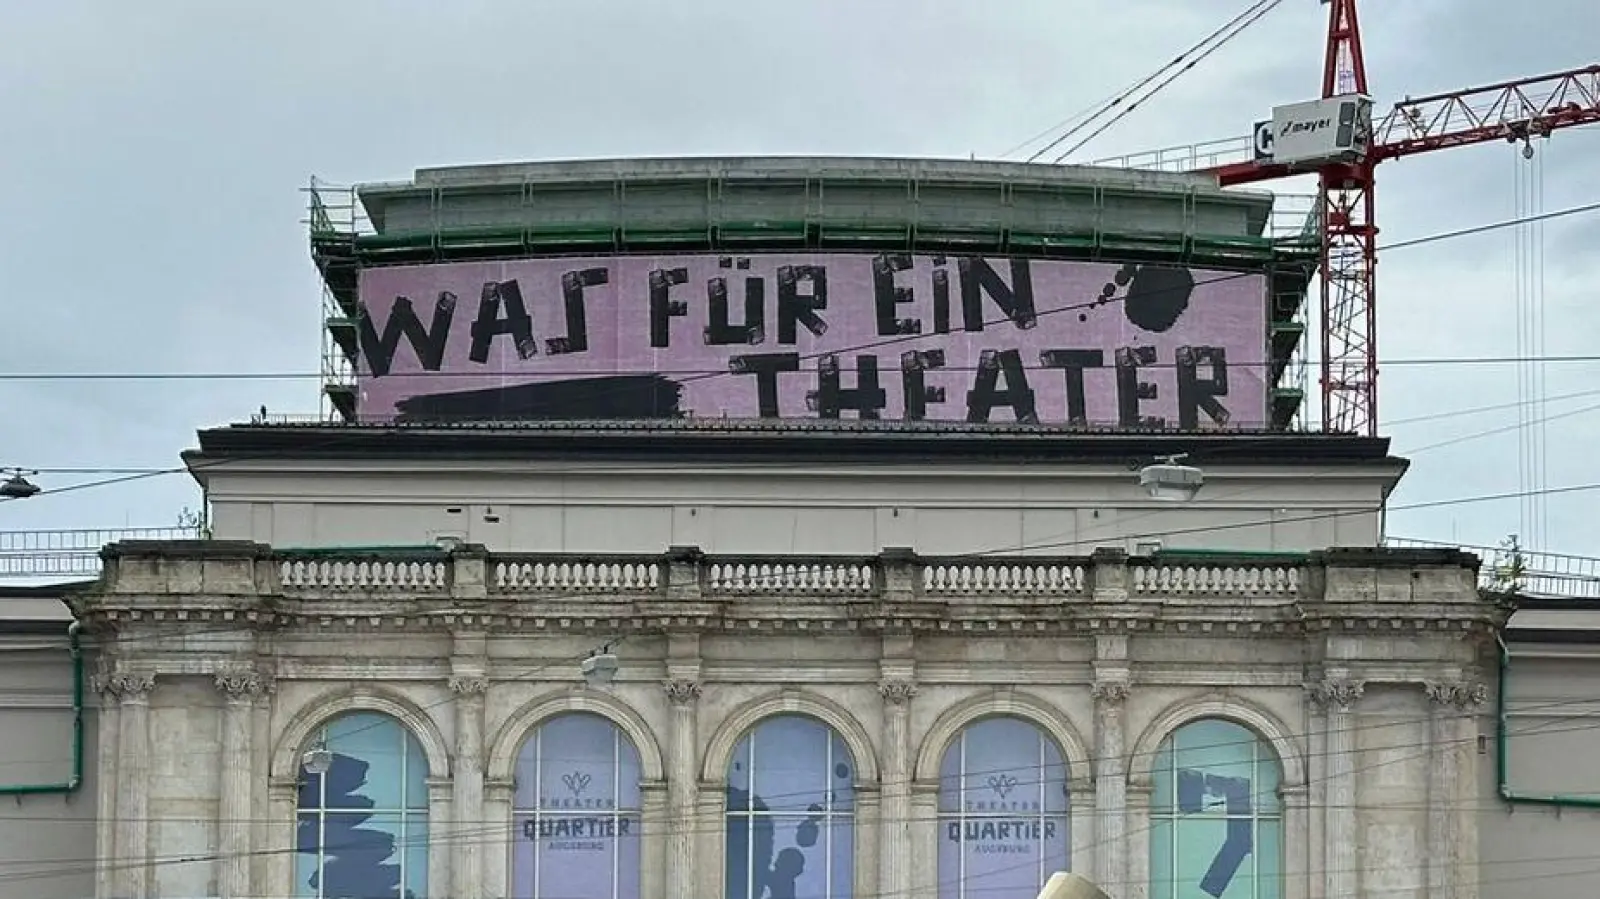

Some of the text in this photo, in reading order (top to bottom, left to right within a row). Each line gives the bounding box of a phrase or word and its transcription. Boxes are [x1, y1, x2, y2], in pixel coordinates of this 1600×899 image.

[357, 267, 609, 378] WAS
[648, 257, 829, 348] FÜR
[729, 346, 1230, 427] THEATER
